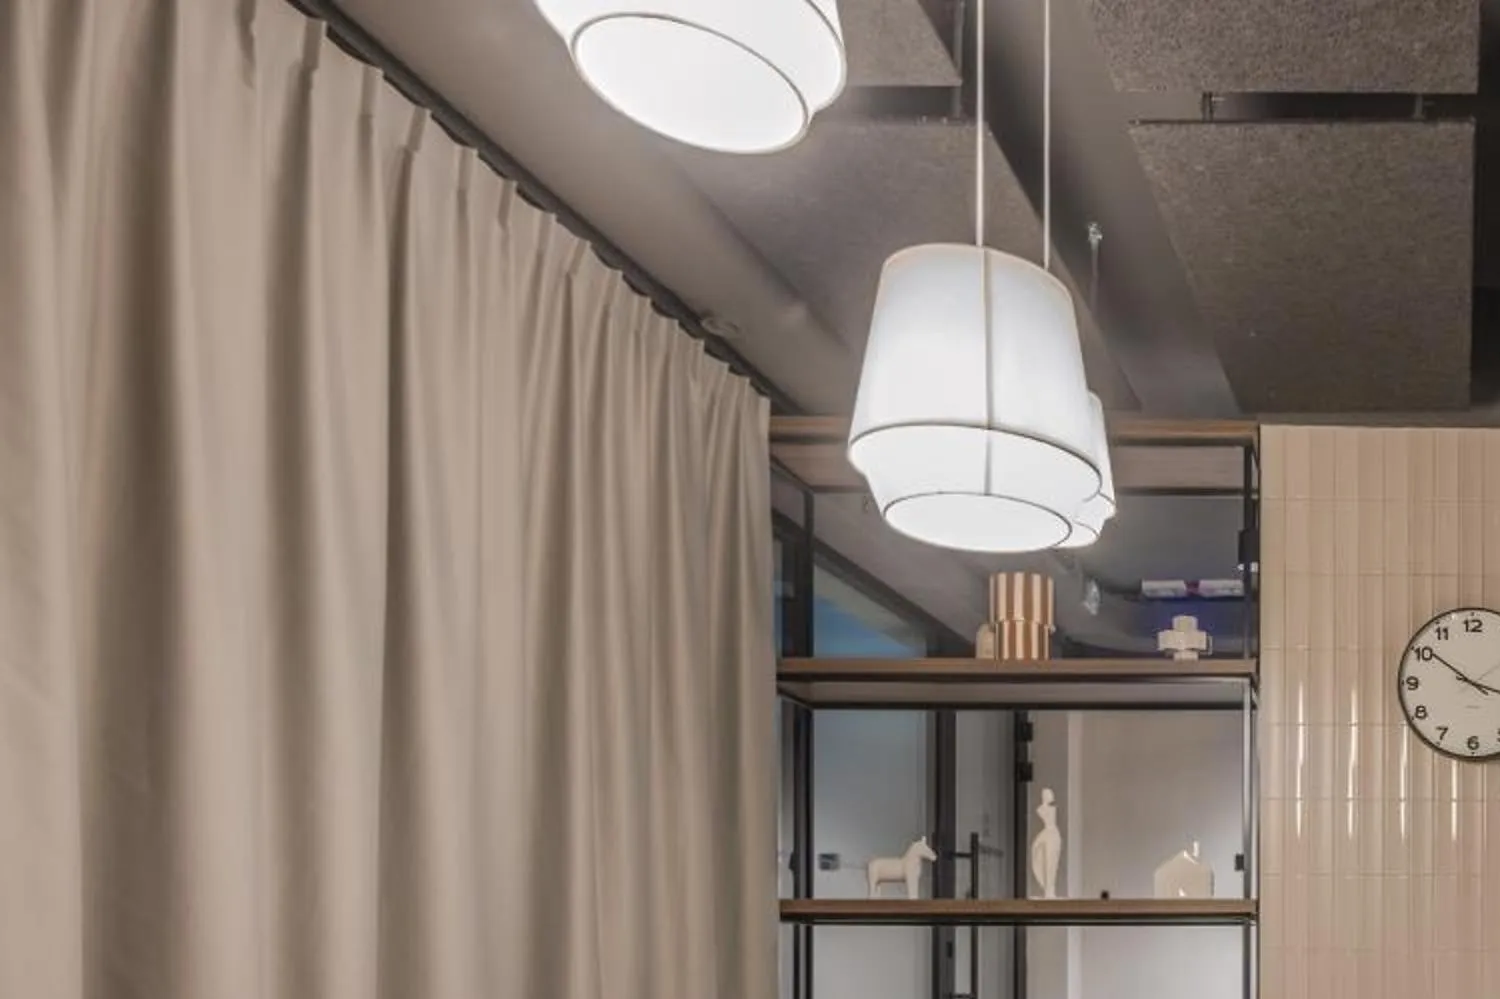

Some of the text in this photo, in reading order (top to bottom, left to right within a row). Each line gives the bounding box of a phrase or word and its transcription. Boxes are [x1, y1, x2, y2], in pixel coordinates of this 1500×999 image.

[1463, 618, 1484, 633] 12
[1435, 627, 1449, 641] 11
[1414, 646, 1433, 662] 10
[1405, 675, 1420, 691] 9
[1414, 705, 1428, 720] 8
[1436, 726, 1449, 741] 7
[1466, 735, 1480, 750] 6
